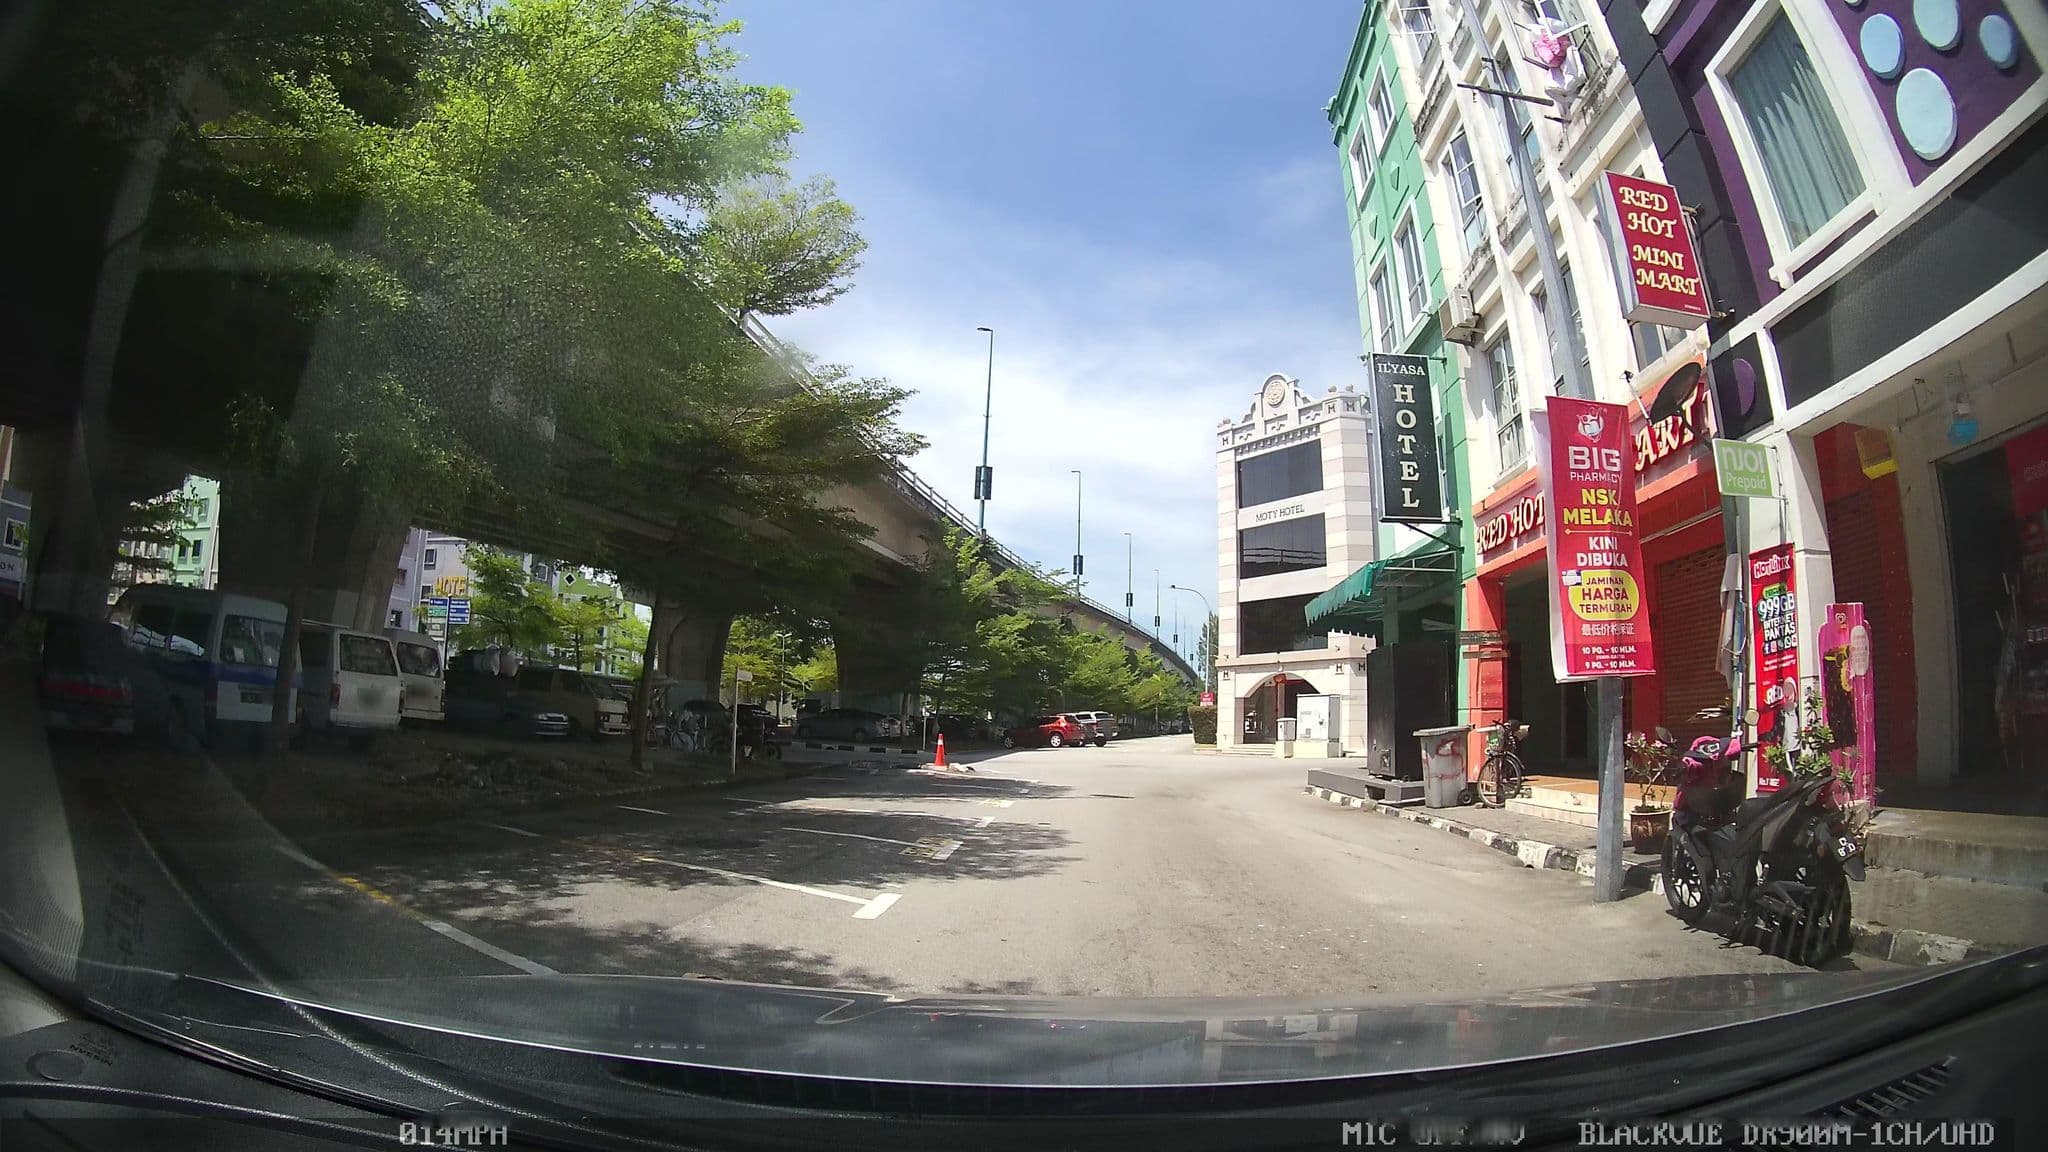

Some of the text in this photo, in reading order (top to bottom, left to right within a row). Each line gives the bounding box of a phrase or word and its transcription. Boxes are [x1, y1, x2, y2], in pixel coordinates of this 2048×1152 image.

[1619, 187, 1669, 212] RED
[1627, 212, 1677, 238] HOT
[1633, 245, 1684, 270] MINI
[1636, 268, 1699, 296] MART
[1393, 384, 1420, 508] HOTEL
[1568, 446, 1621, 471] BIG
[1725, 472, 1767, 492] Prepaid
[1582, 488, 1618, 505] NSK
[1256, 504, 1305, 522] MOTY HOTEL
[1563, 508, 1633, 527] MELAKA
[1476, 492, 1545, 554] RED HOT
[1588, 536, 1618, 551] KINI
[1576, 552, 1628, 567] DIBUKA
[1586, 576, 1624, 586] JAMINAN
[1582, 588, 1629, 601] HARGA
[1579, 603, 1633, 613] TERMURAH
[1764, 623, 1796, 641] PANTAS
